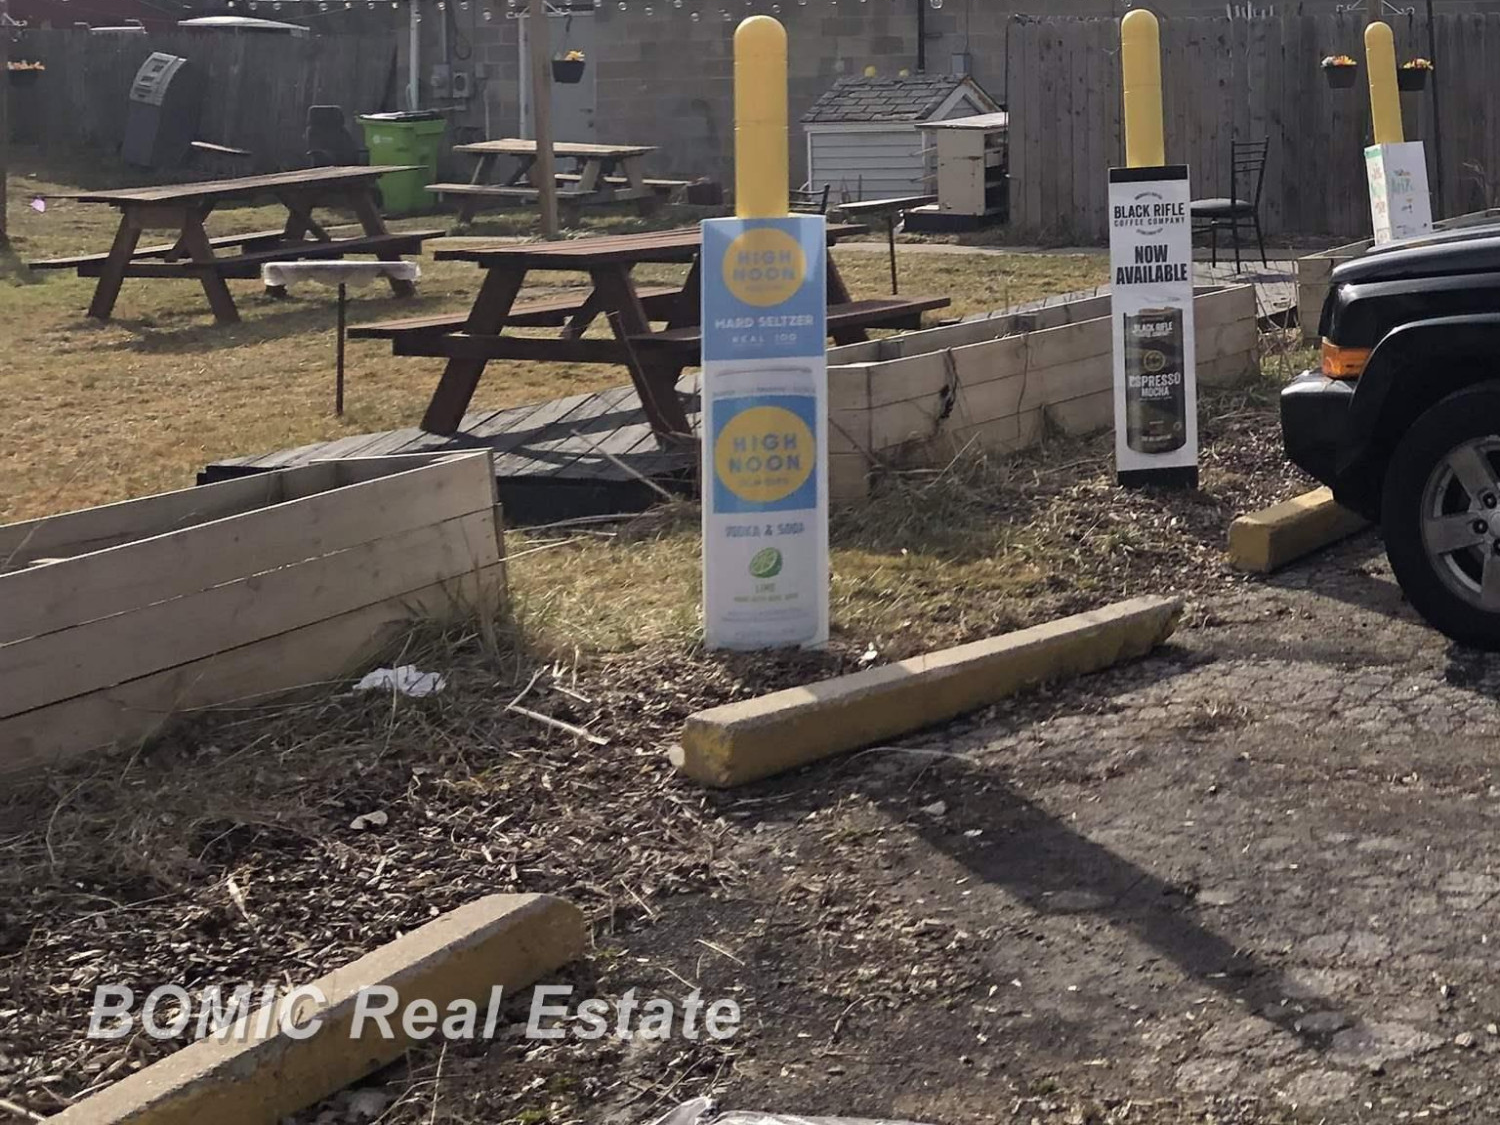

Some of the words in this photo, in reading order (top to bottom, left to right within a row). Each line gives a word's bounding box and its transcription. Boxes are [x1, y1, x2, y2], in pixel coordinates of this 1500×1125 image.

[1114, 204, 1150, 219] BLACK
[1153, 203, 1185, 217] RIFLE
[1114, 219, 1144, 227] COFFEE
[1148, 217, 1185, 225] COMPANY
[738, 250, 792, 264] HIGH
[1135, 244, 1168, 264] NOW
[732, 268, 796, 281] NOON
[1116, 263, 1188, 285] AVAILABLE
[715, 317, 755, 329] HARD
[758, 315, 814, 327] SELTZER
[1128, 372, 1181, 387] ESPRESSO
[1141, 386, 1169, 397] MOCHA
[733, 433, 797, 452] HIGH
[729, 455, 800, 473] NOON
